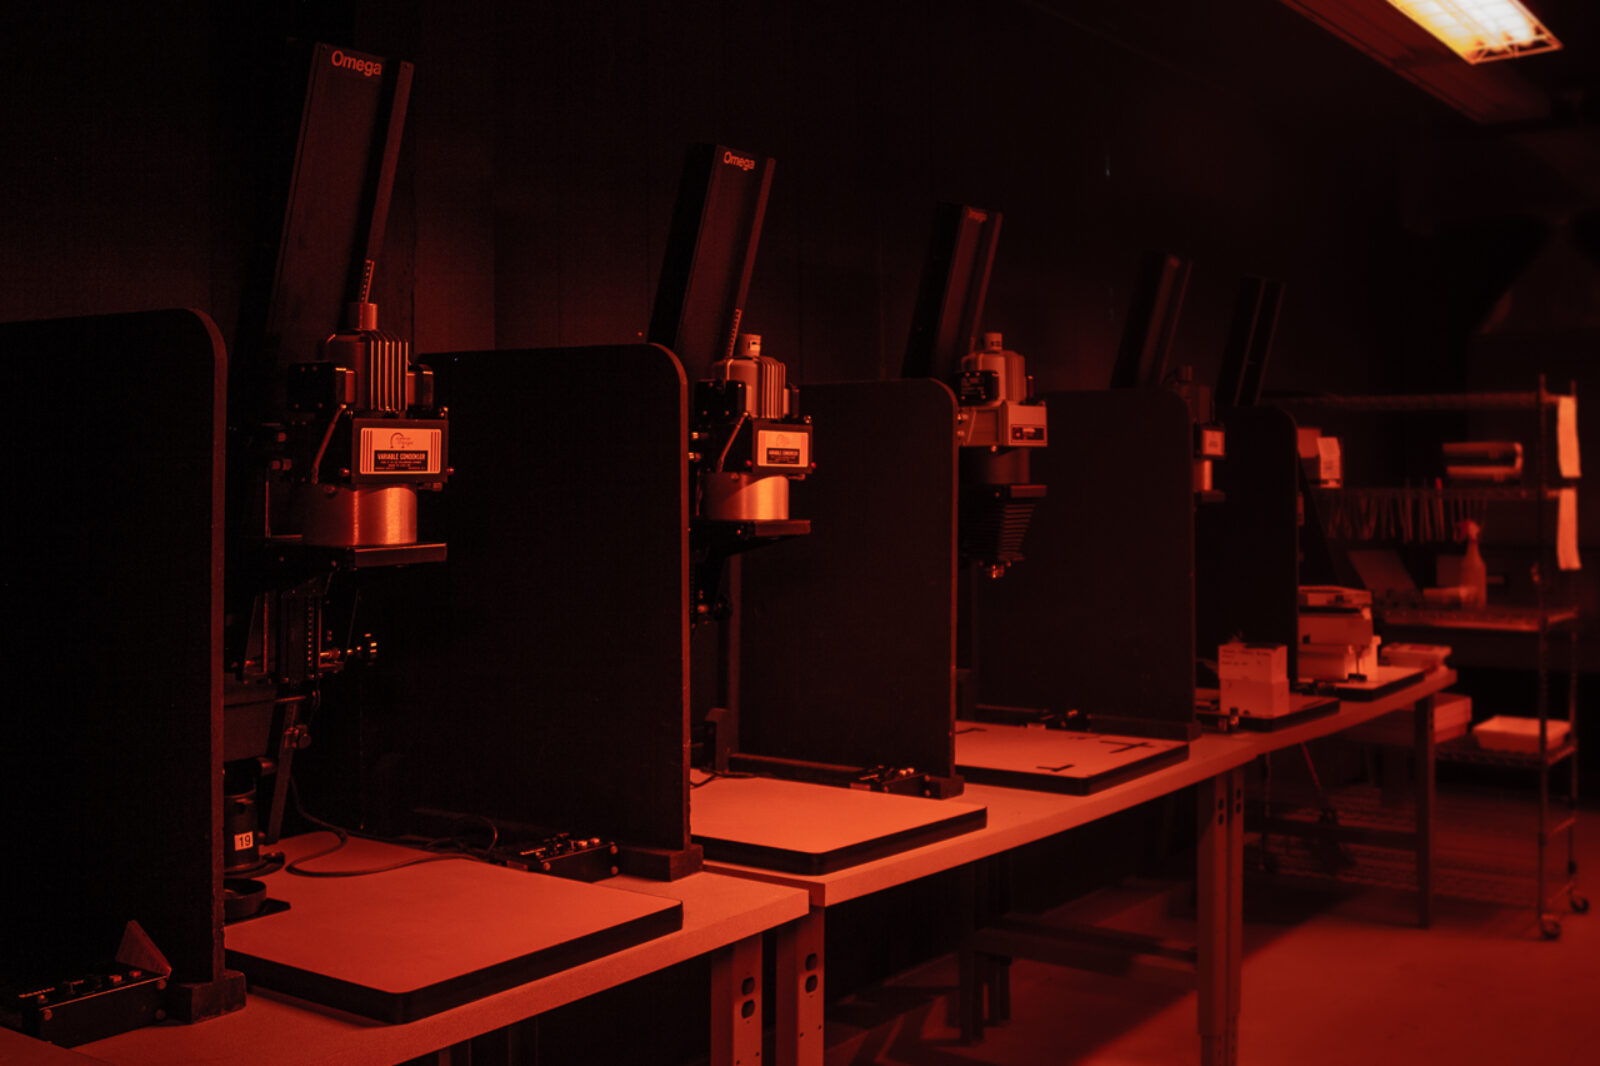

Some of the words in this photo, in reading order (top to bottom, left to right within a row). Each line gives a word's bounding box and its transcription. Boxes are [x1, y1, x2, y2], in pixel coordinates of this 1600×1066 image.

[331, 50, 382, 78] Omega
[723, 151, 755, 171] Omega
[240, 835, 250, 847] 19
